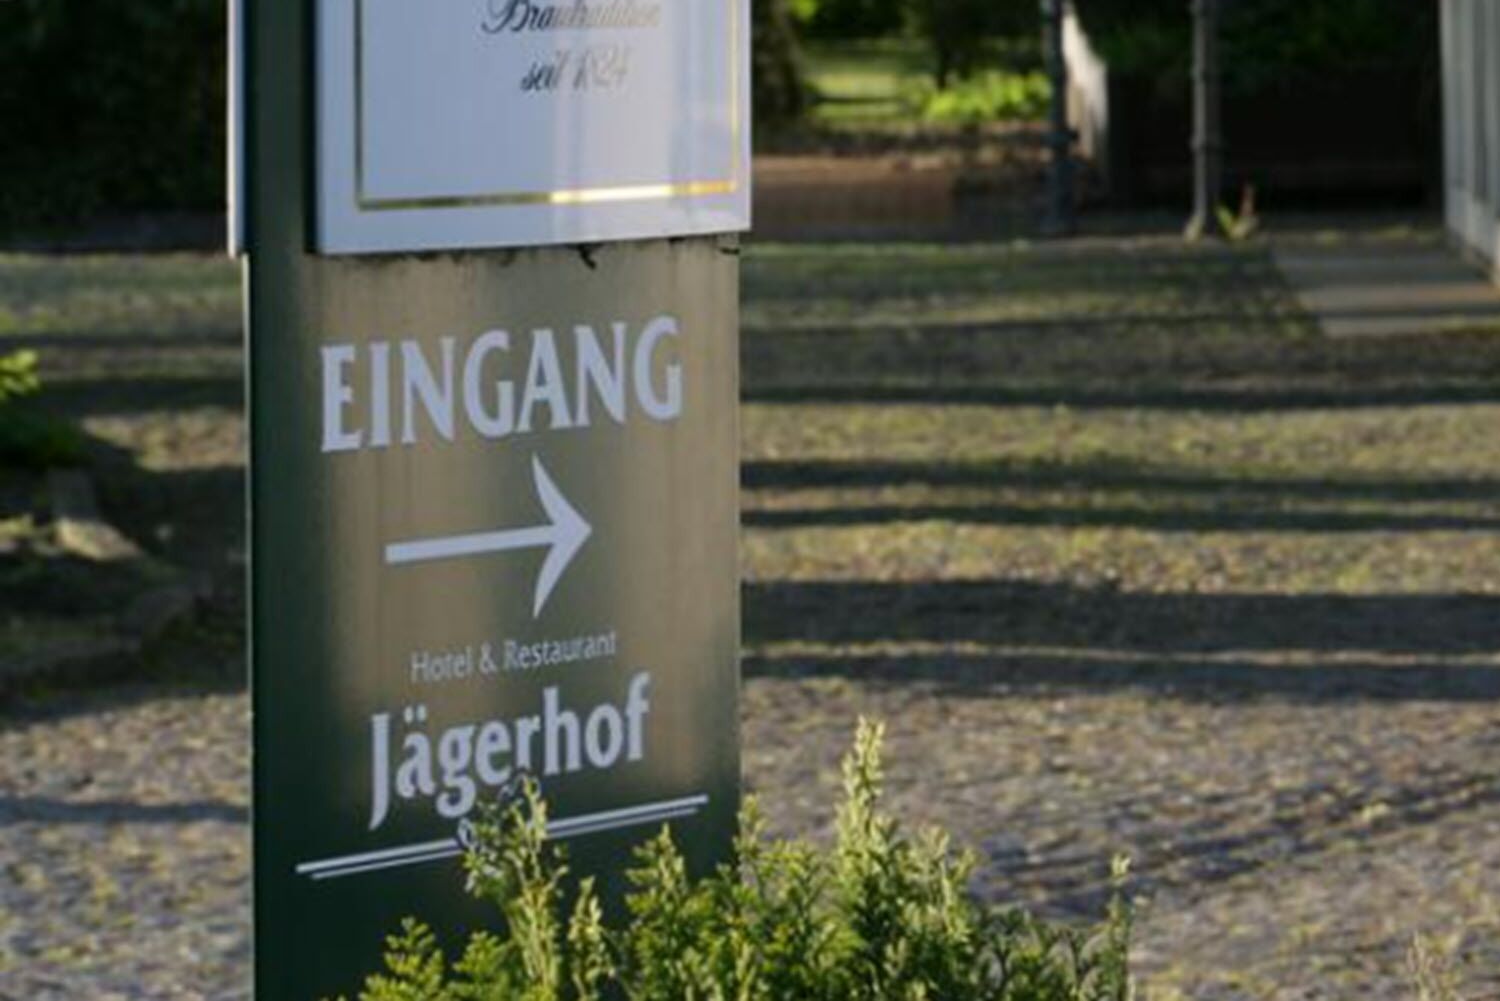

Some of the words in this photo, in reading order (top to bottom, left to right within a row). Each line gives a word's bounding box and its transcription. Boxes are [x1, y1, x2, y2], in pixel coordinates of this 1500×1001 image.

[320, 316, 683, 452] EINGANG
[410, 645, 473, 682] Hotel
[478, 642, 498, 675] &
[503, 629, 617, 670] Restaurant
[369, 671, 651, 831] Jägerhof
